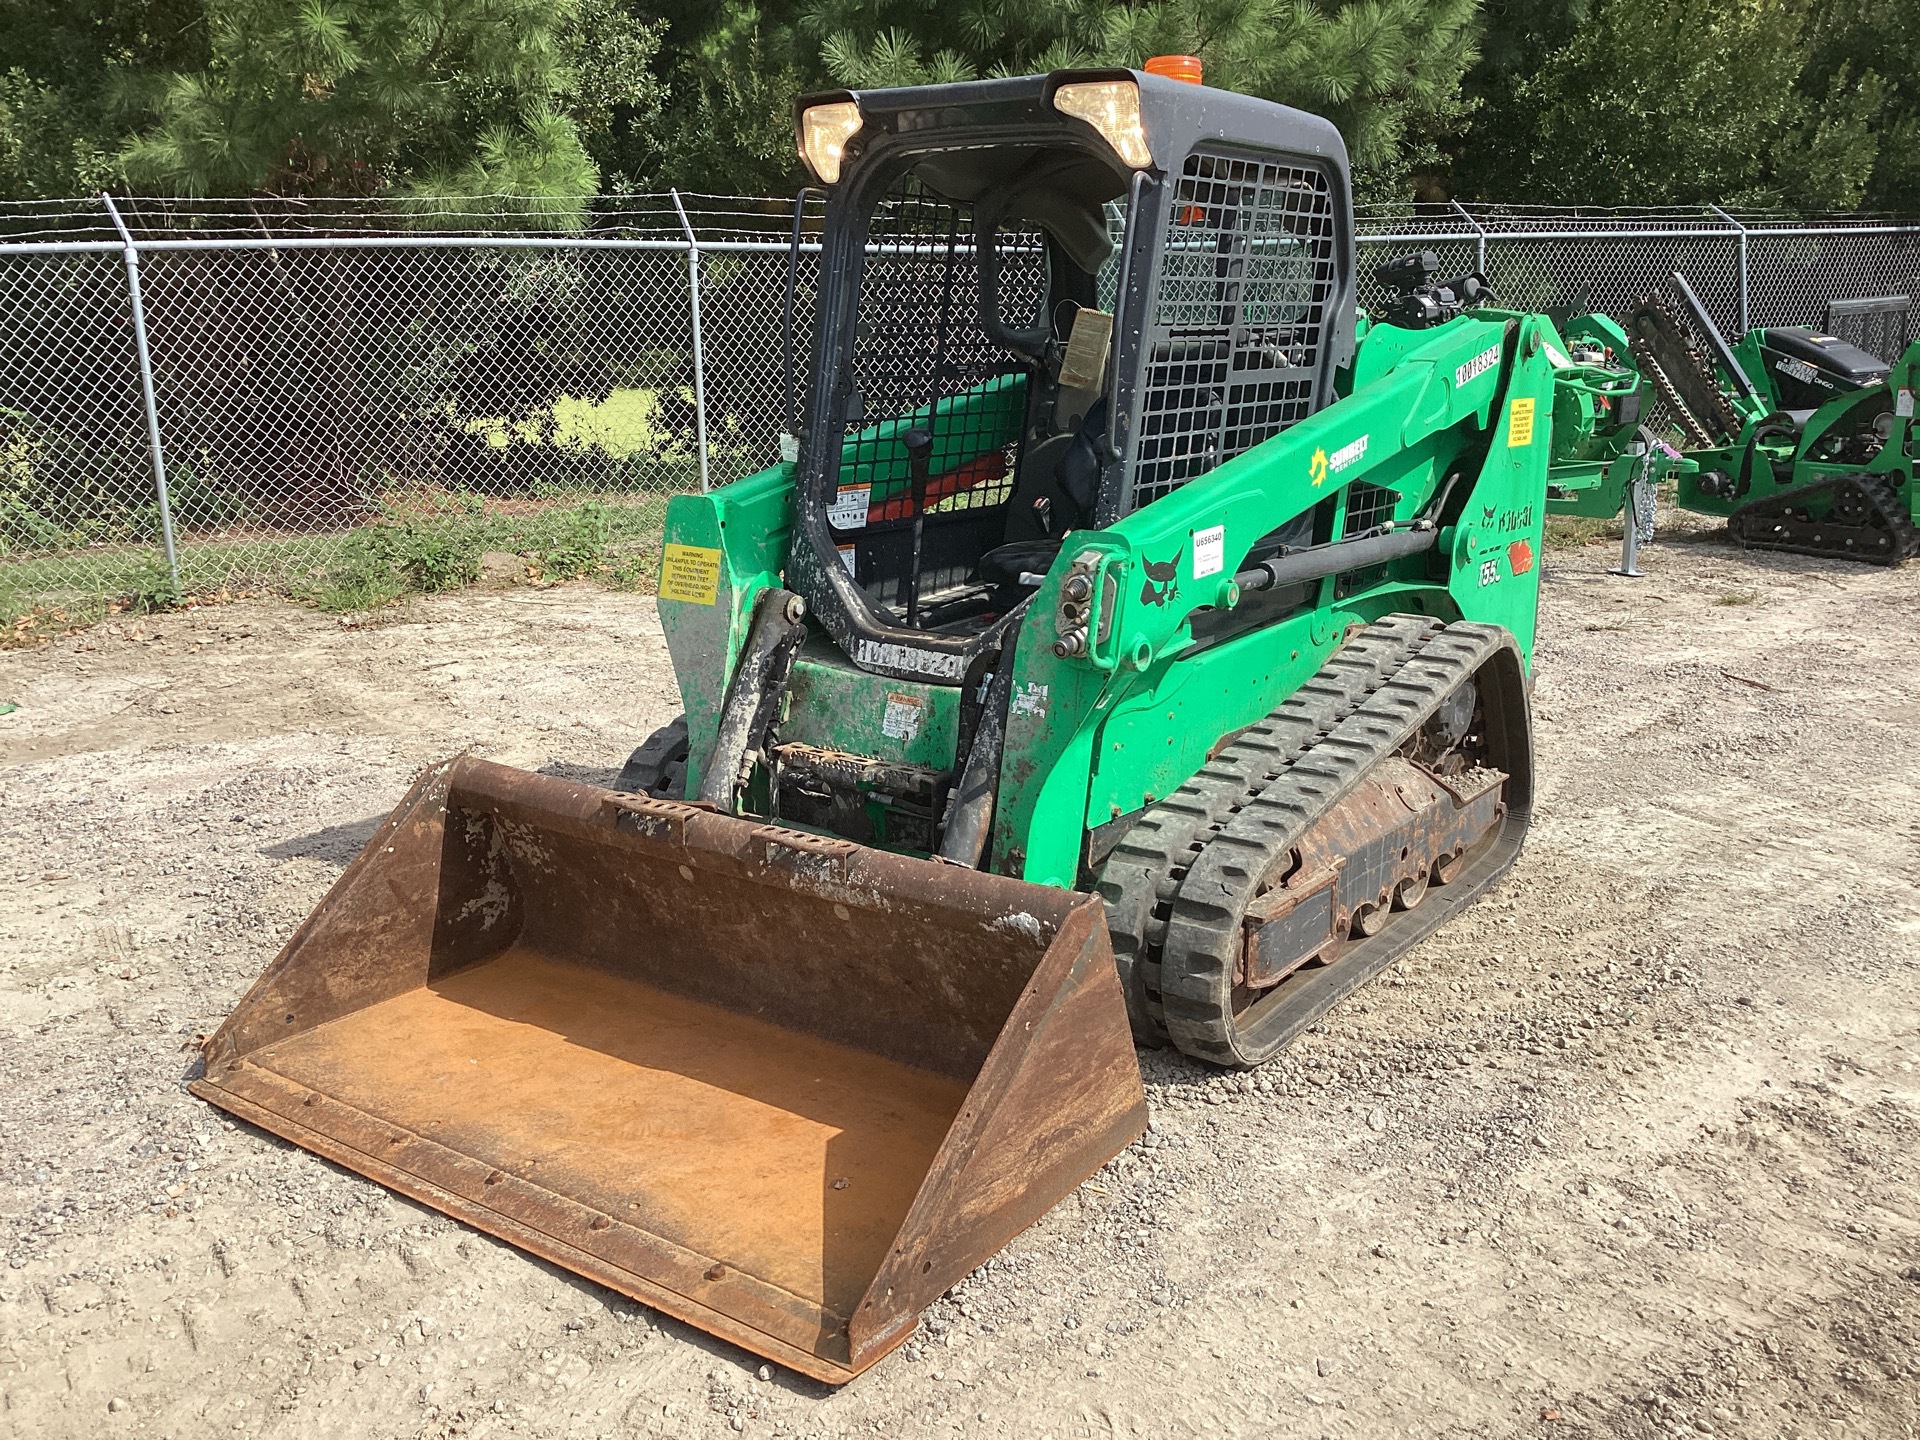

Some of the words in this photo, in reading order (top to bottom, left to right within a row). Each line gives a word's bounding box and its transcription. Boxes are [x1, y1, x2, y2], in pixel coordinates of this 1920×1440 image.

[1456, 345, 1499, 386] 10018324
[1814, 377, 1834, 389] DINGO
[1329, 433, 1369, 471] SUNBELT
[1334, 452, 1364, 474] RENTALS
[1195, 532, 1222, 548] U656340
[674, 581, 699, 589] OVERHEAD
